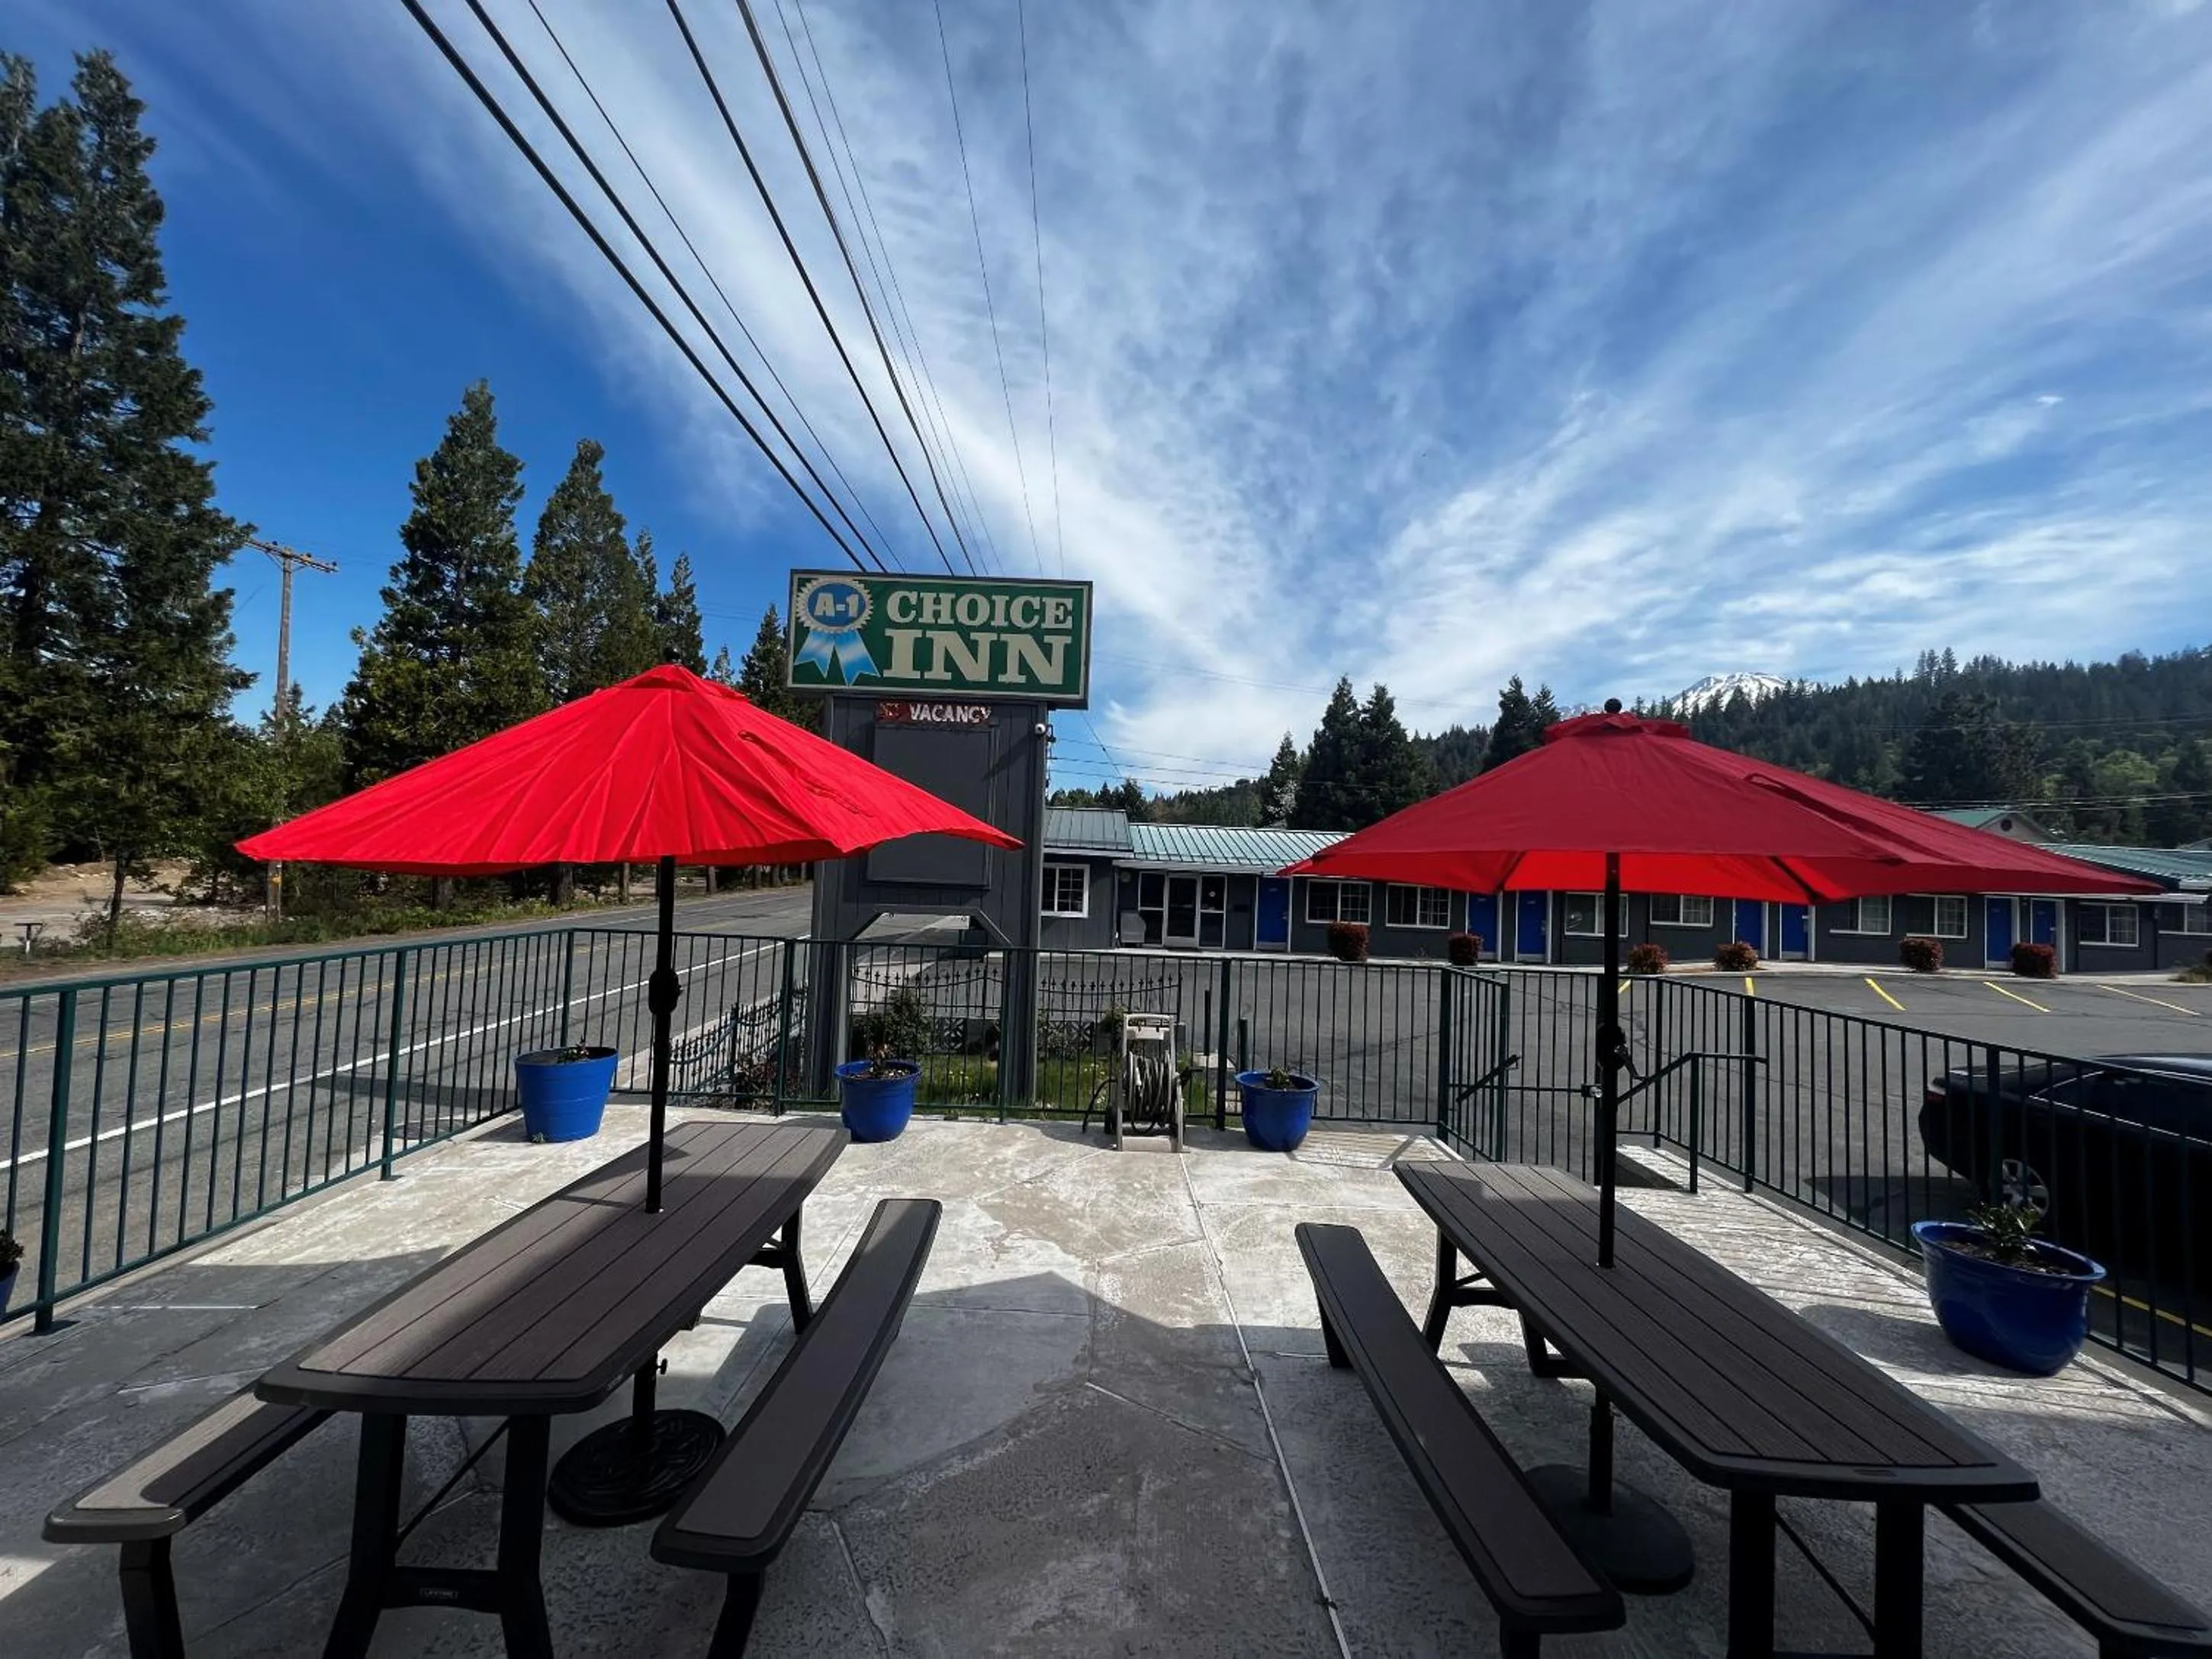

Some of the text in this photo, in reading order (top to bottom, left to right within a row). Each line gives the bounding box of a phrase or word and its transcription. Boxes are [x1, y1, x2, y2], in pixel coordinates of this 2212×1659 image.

[814, 593, 859, 617] A-1
[887, 590, 1073, 629] CHOICE
[883, 629, 1072, 685] INN
[910, 703, 992, 723] VACANCY
